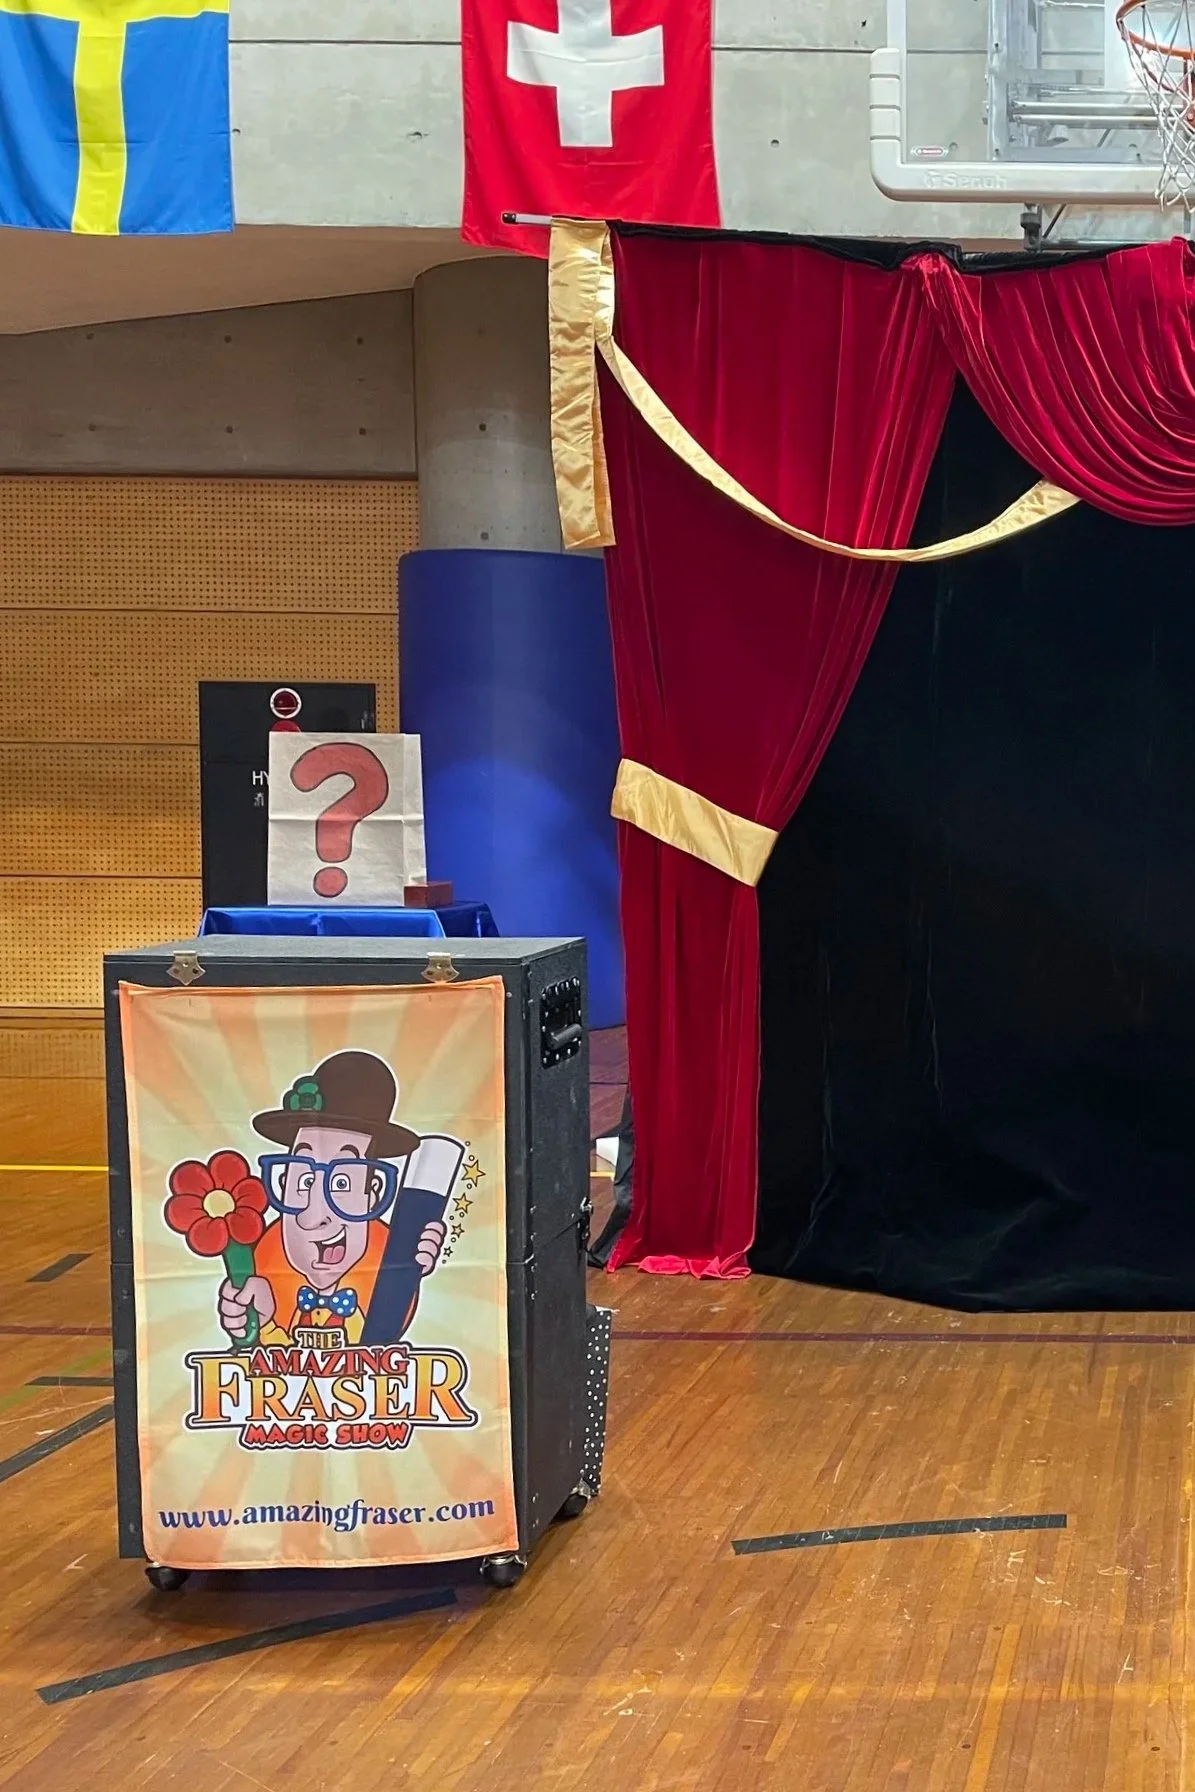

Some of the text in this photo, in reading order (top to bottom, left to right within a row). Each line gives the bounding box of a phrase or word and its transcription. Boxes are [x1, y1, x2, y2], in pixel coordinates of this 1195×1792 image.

[290, 742, 389, 898] ?
[298, 1331, 342, 1349] THE
[250, 1347, 408, 1378] AMAZING
[192, 1355, 472, 1423] FRASER
[245, 1423, 408, 1446] MAGIC SHOW
[159, 1499, 495, 1532] www.amazingfraser.com
